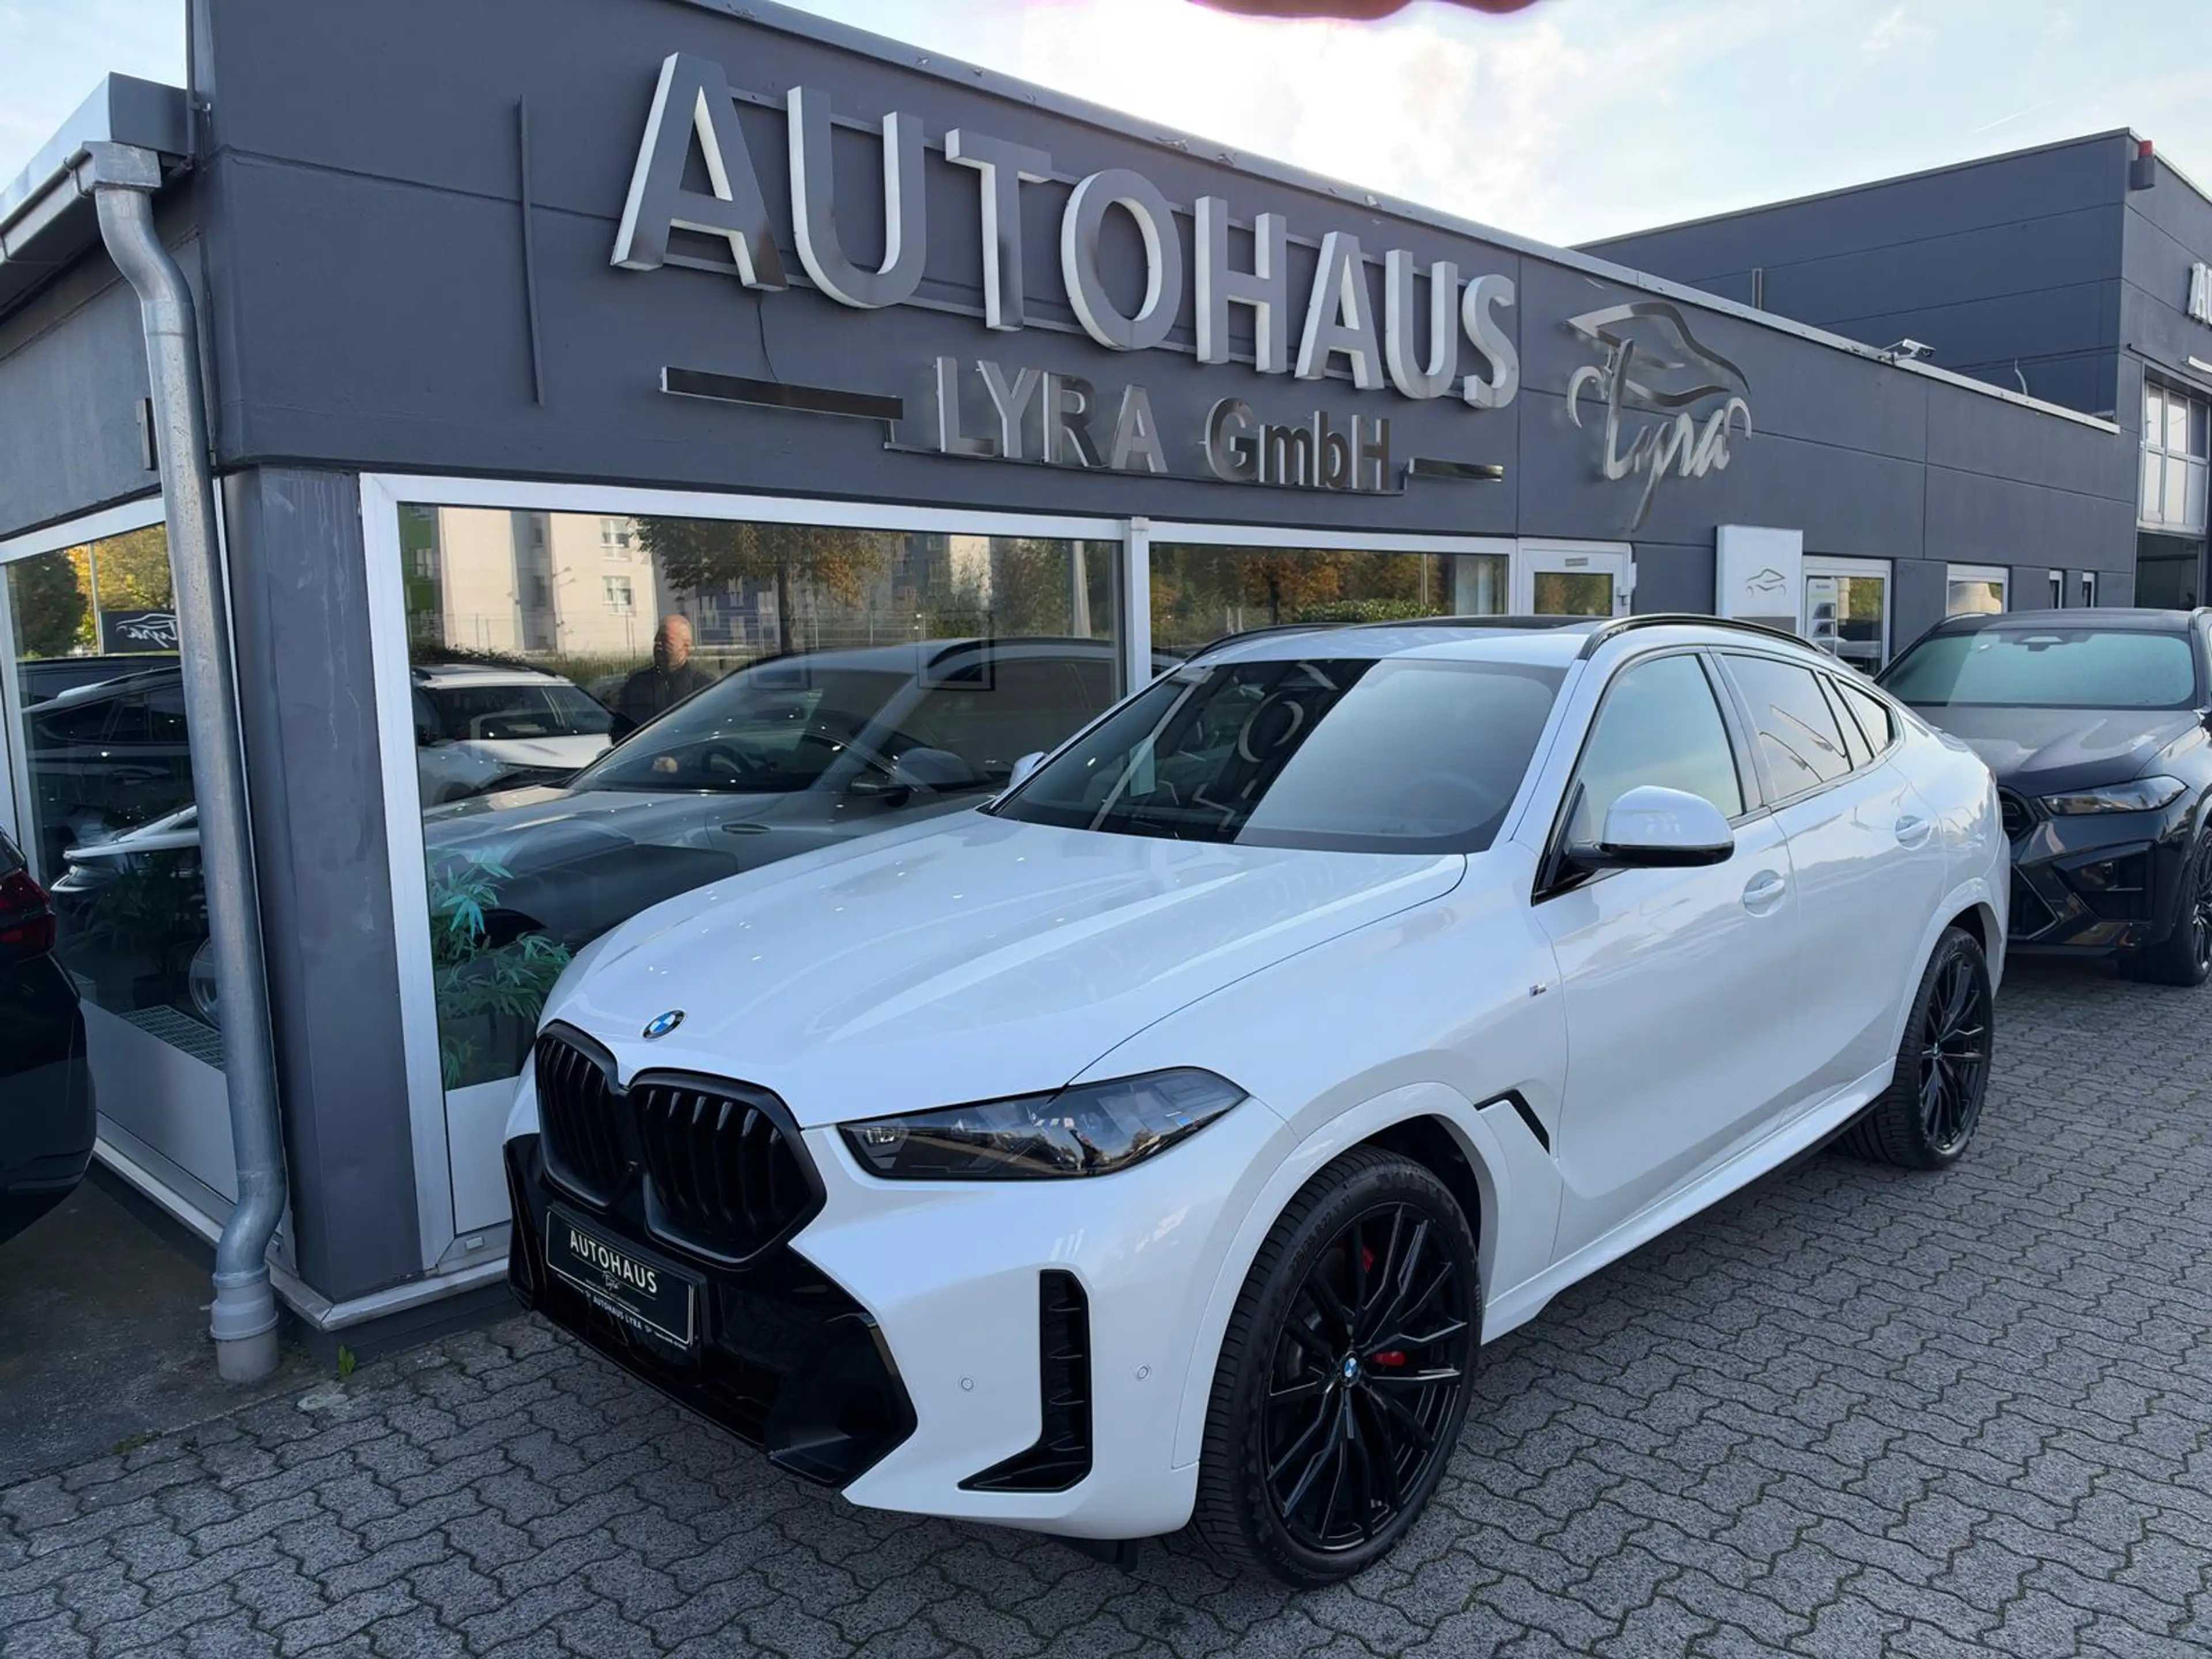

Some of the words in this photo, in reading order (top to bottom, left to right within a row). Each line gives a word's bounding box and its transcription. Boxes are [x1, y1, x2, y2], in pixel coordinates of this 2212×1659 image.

[611, 52, 1520, 410] AUTOHAUS
[936, 356, 1168, 474] LYRA
[1206, 397, 1390, 491] GmbH
[570, 1229, 657, 1294] AUTOHAUS
